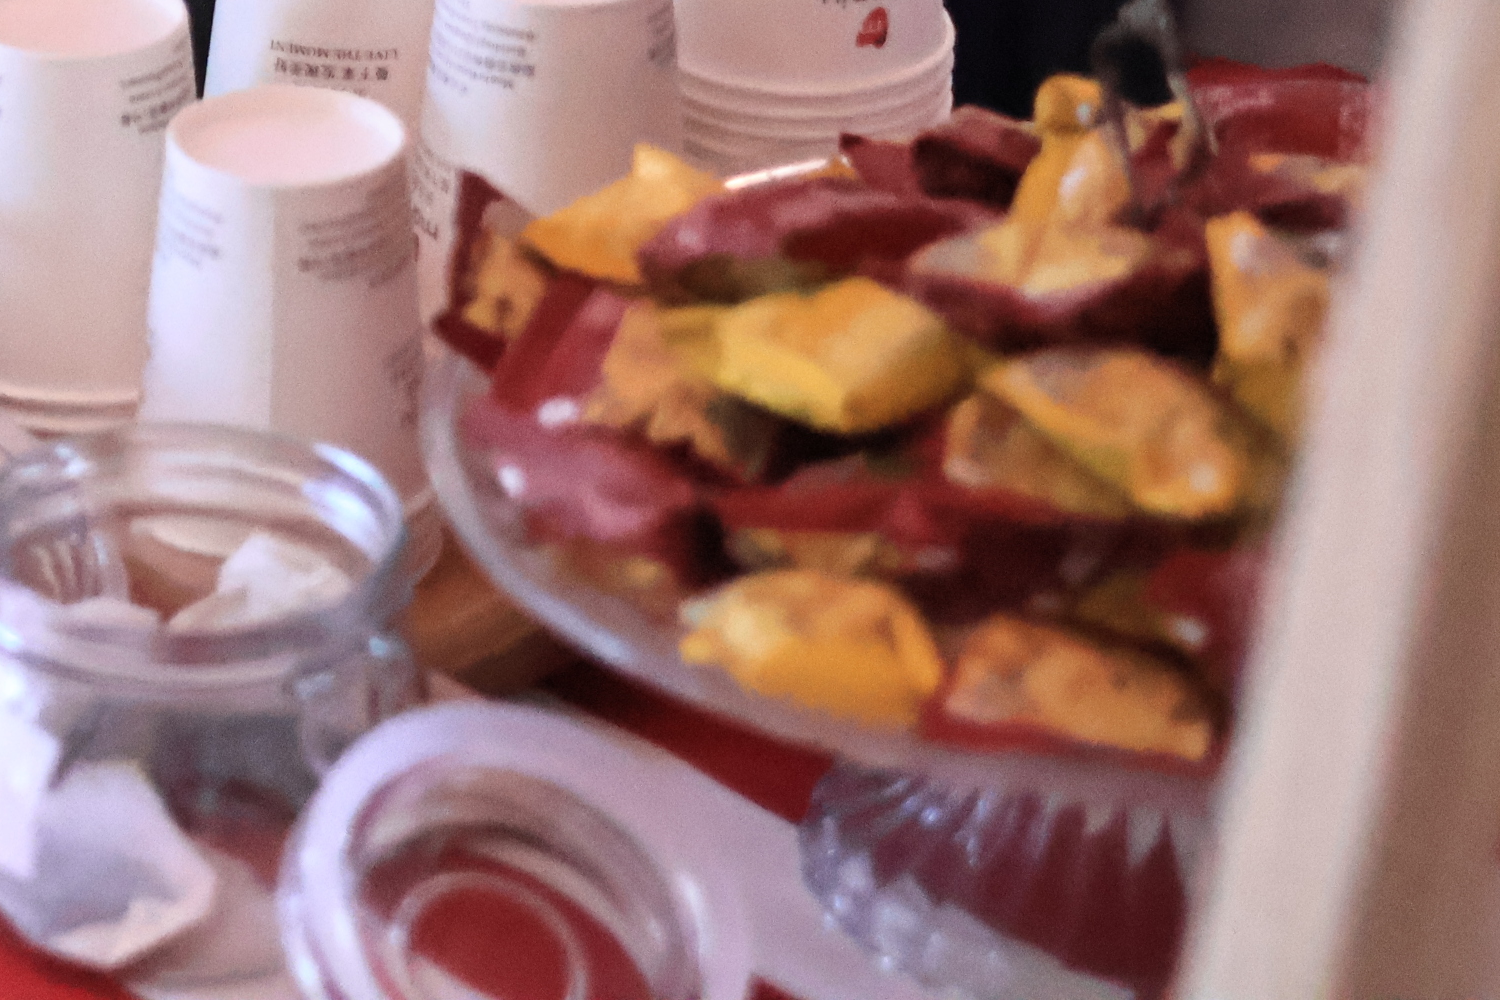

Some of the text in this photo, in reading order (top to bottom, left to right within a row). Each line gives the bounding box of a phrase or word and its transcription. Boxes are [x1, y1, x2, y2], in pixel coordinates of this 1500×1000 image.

[270, 39, 399, 61] LIVE THE MOMENT
